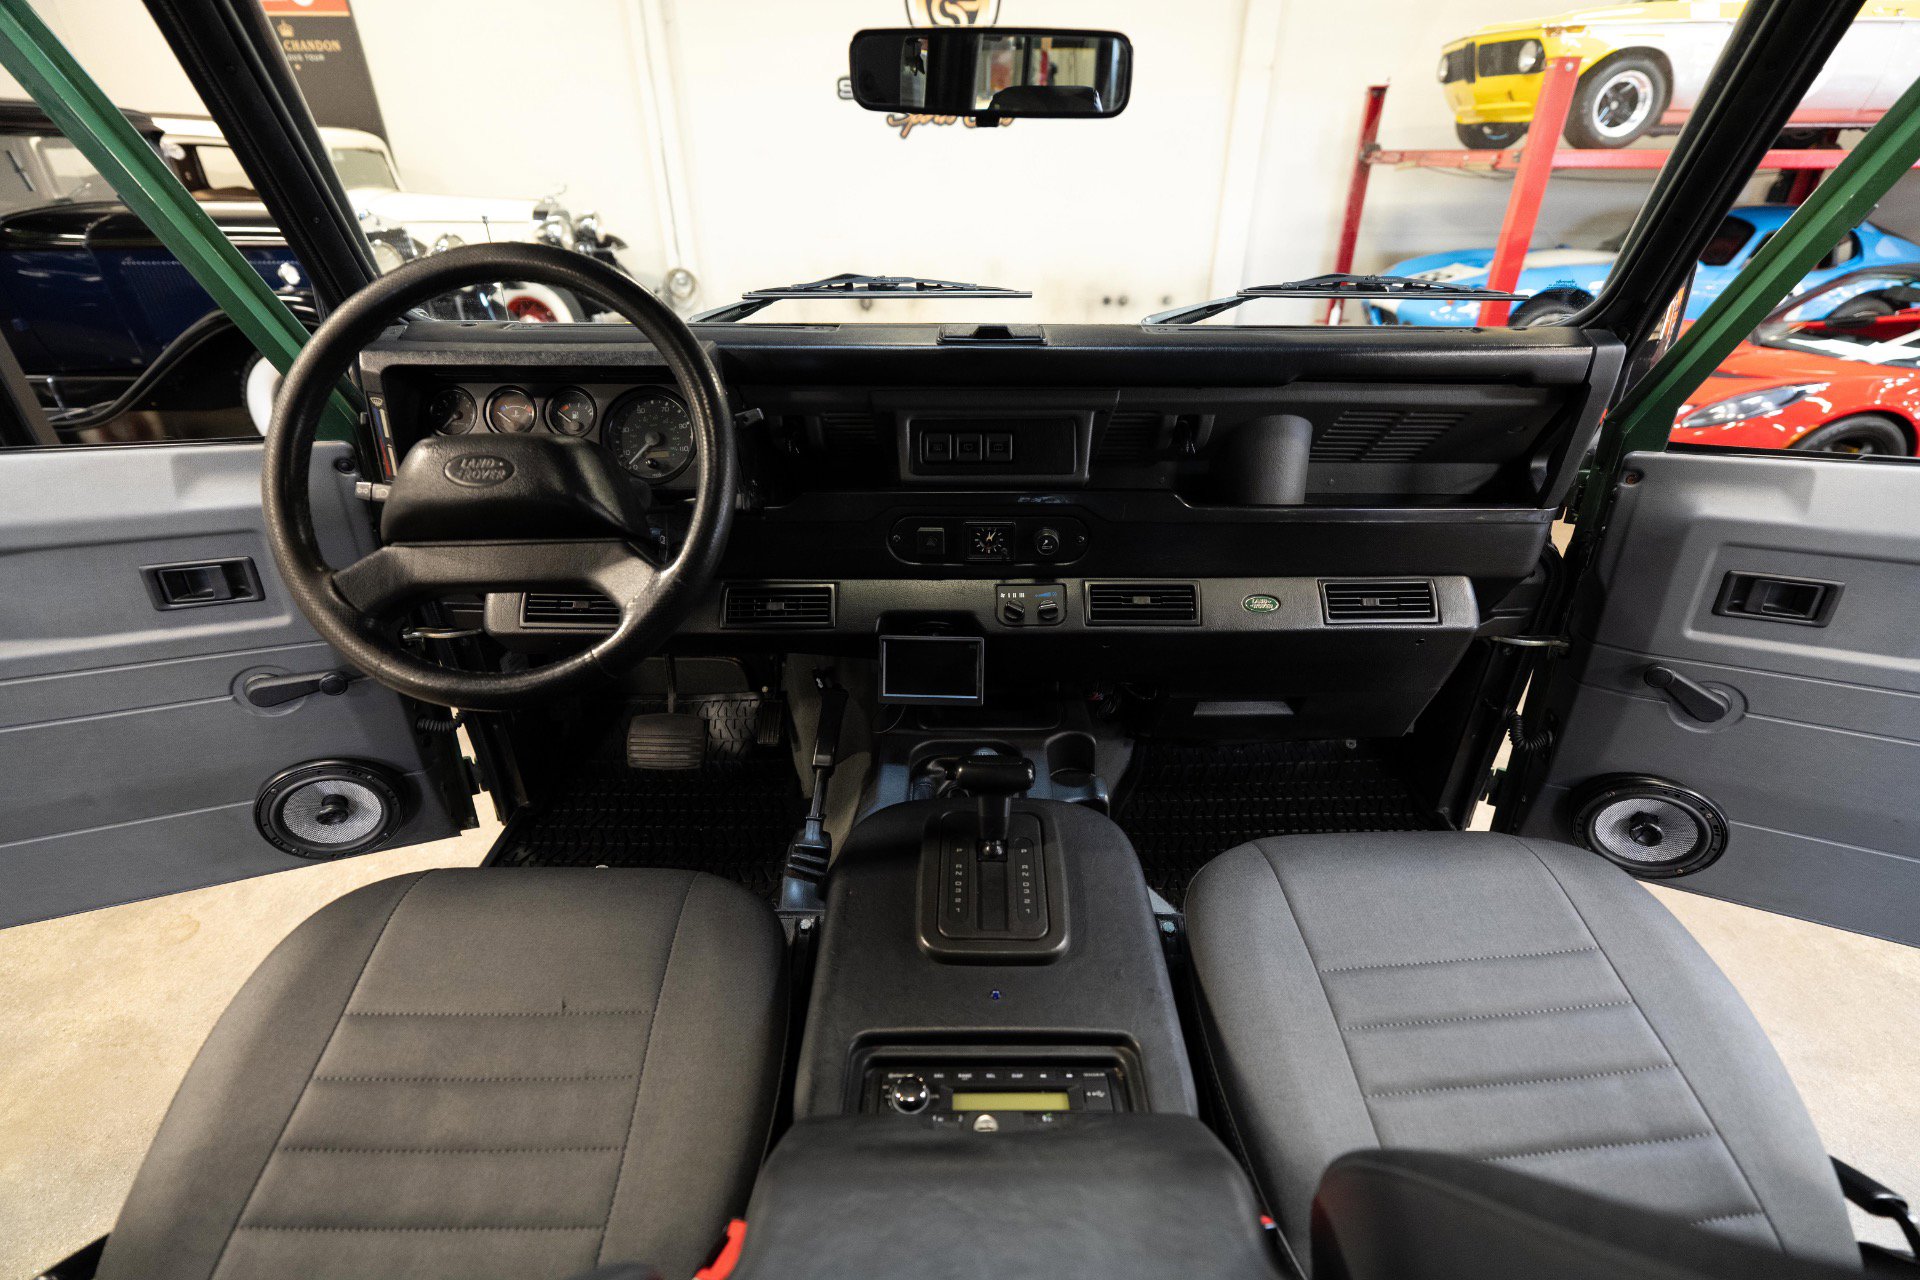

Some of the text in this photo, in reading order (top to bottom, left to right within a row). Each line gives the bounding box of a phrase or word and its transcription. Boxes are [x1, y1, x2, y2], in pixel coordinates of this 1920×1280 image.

[283, 39, 341, 51] CHANDON
[461, 458, 495, 469] LAND
[462, 469, 506, 481] ROVER
